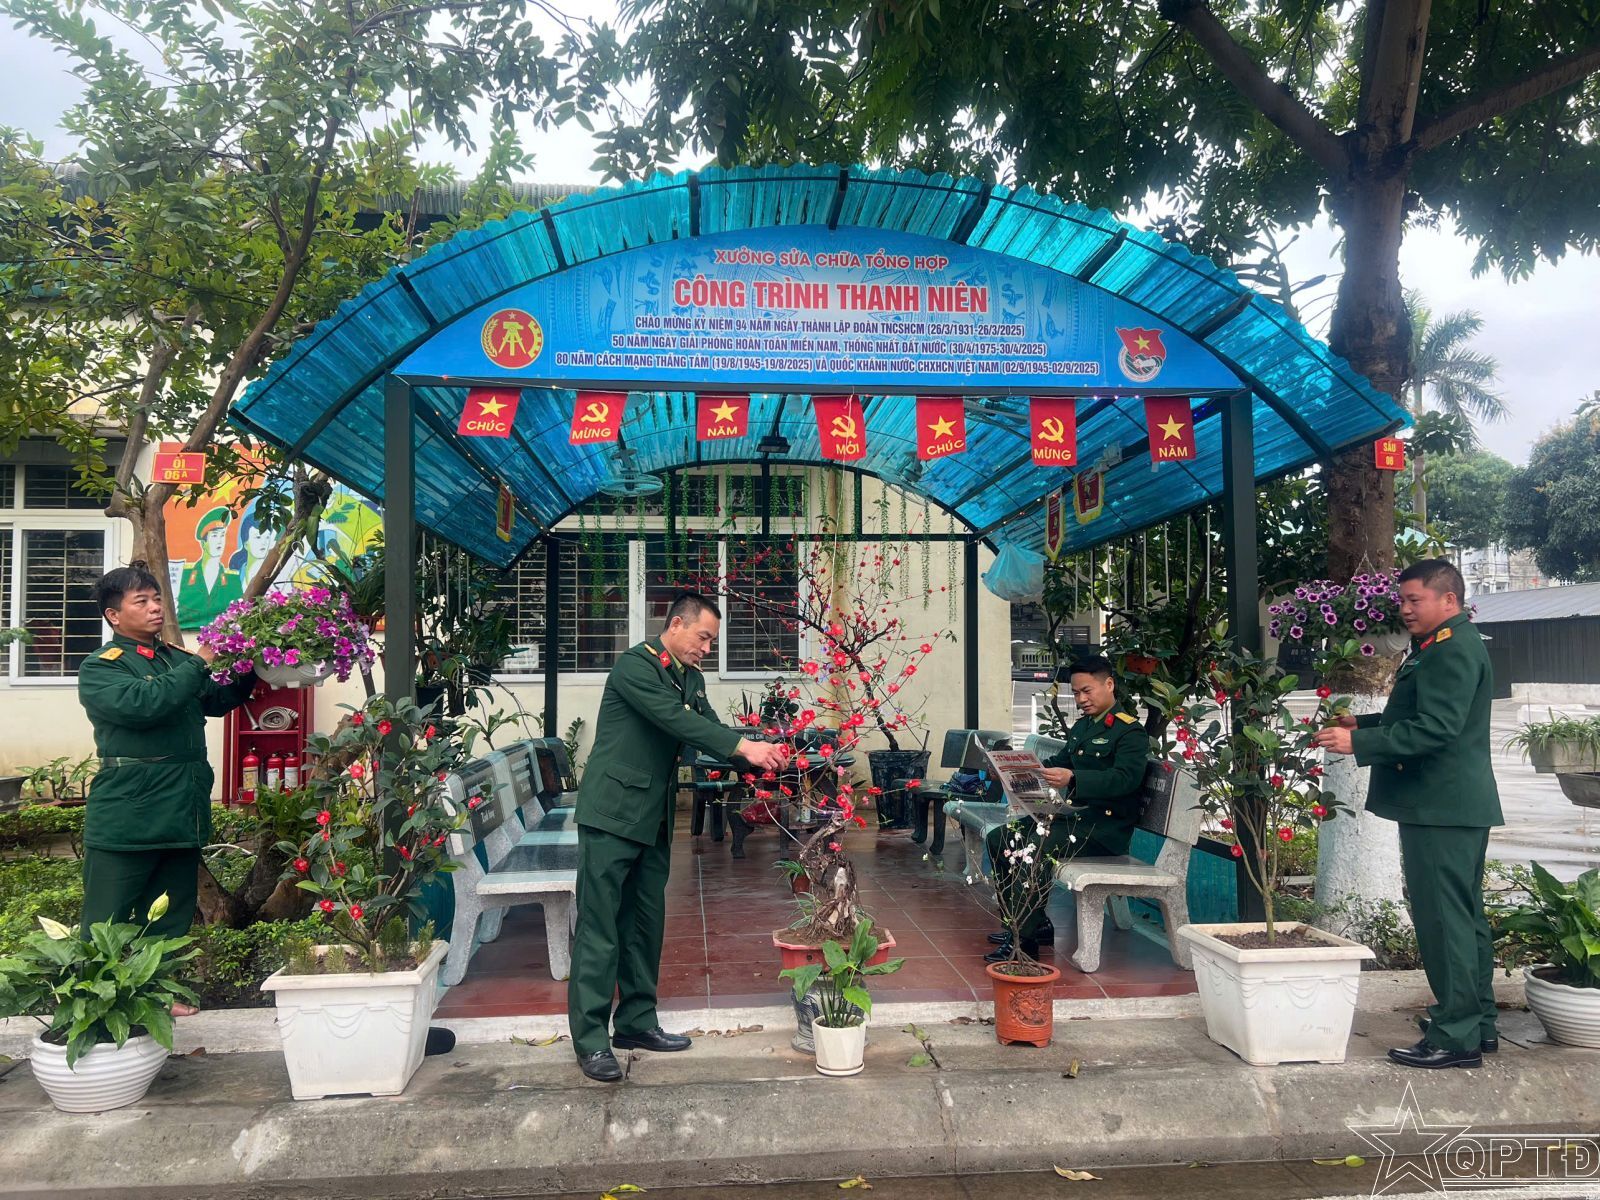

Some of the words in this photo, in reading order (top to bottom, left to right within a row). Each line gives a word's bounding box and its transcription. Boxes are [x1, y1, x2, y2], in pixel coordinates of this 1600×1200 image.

[715, 246, 776, 266] XƯỞNG
[780, 248, 811, 267] SỬA
[815, 251, 861, 268] CHỮA
[865, 248, 910, 269] TỔNG
[914, 255, 949, 273] HỢP
[674, 274, 746, 308] CÔNG
[753, 277, 829, 309] TRÌNH
[836, 284, 919, 311] THANH
[928, 281, 988, 313] NIÊN
[635, 315, 661, 329] CHÀO
[663, 315, 692, 330] MỪNG
[709, 317, 733, 332] NIỆM
[735, 319, 748, 331] 94
[750, 317, 771, 332] NĂM
[774, 318, 799, 332] NGÀY
[801, 319, 831, 334] THÀNH
[833, 319, 851, 336] LẬP
[853, 320, 879, 334] ĐOÀN
[881, 322, 925, 335] TNCSHCM
[927, 322, 1025, 337] (26/3/1931-26/3/2025)
[611, 335, 625, 348] 50
[627, 333, 649, 348] NĂM
[651, 334, 677, 349] NGÀY
[679, 333, 699, 349] GIẢI
[701, 334, 733, 350] PHÓNG
[735, 336, 761, 351] HOÀN
[763, 337, 788, 351] TOÀN
[816, 340, 842, 354] NAM,
[844, 338, 873, 353] THỐNG
[875, 338, 900, 353] NHẤT
[902, 338, 920, 354] ĐẤT
[921, 340, 947, 355] NƯỚC
[948, 341, 1047, 356] (30/4/1975-30/4/2025)
[555, 352, 569, 366] 80
[570, 350, 594, 367] NĂM
[596, 351, 622, 367] CÁCH
[624, 354, 654, 370] MẠNG
[656, 353, 687, 368] THÁNG
[689, 353, 710, 369] TÁM
[711, 356, 813, 371] (19/8/1945-19/8/2025)
[815, 356, 828, 371] VÀ
[829, 355, 855, 373] QUỐC
[857, 357, 889, 372] KHÁNH
[890, 357, 915, 373] NƯỚC
[917, 359, 955, 373] CHXHCN
[957, 358, 976, 376] VIỆT
[978, 361, 1000, 374] NAM
[1002, 362, 1100, 375] (02/9/1945-02/9/2025)
[466, 419, 507, 432] CHÚC
[571, 426, 612, 440] MỪNG
[706, 425, 739, 437] NĂM
[835, 440, 860, 456] MỚI
[926, 439, 965, 456] CHÚC
[1033, 446, 1072, 461] MỪNG
[1158, 444, 1188, 458] NĂM
